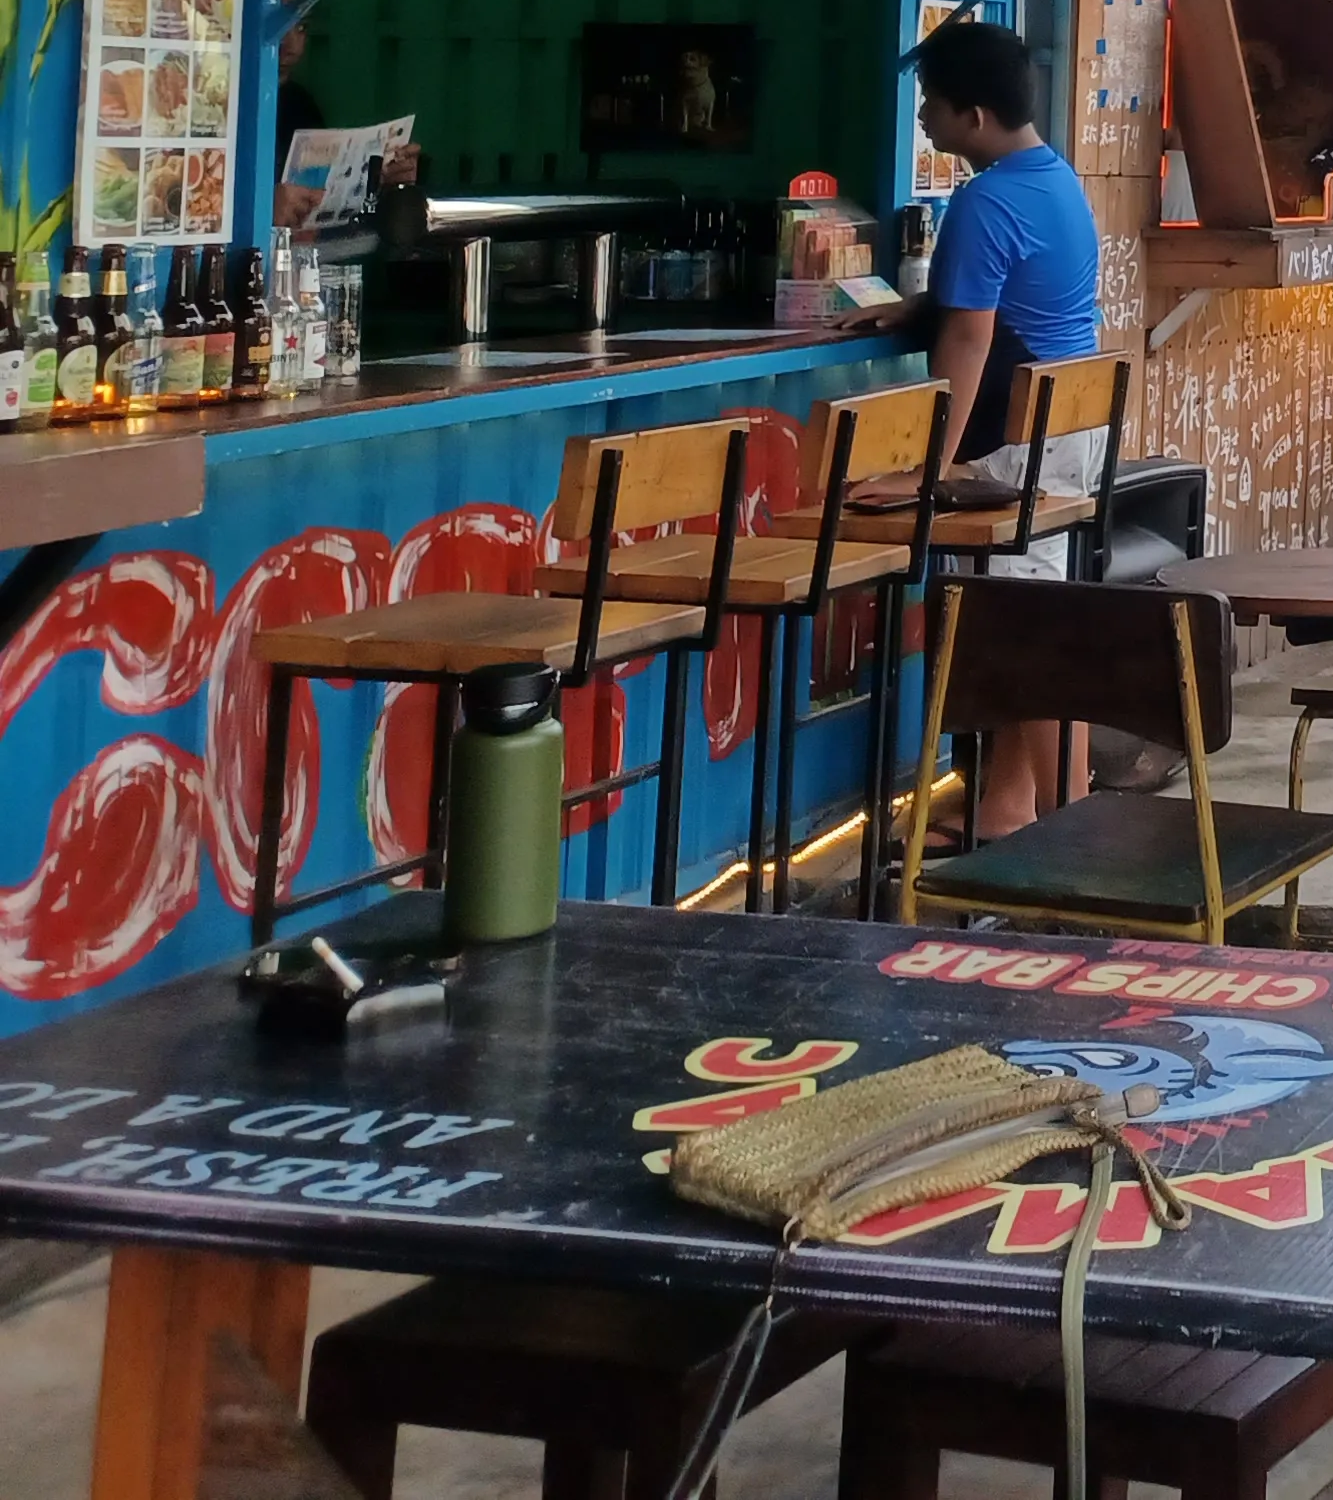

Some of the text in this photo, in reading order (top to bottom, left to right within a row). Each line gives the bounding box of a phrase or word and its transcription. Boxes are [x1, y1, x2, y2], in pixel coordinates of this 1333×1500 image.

[799, 179, 830, 196] MOTI
[876, 941, 1087, 991] BAR
[1052, 960, 1330, 1012] CHIPS
[128, 1094, 245, 1127] A
[229, 1103, 514, 1148] AND
[36, 1135, 503, 1208] FRESH,
